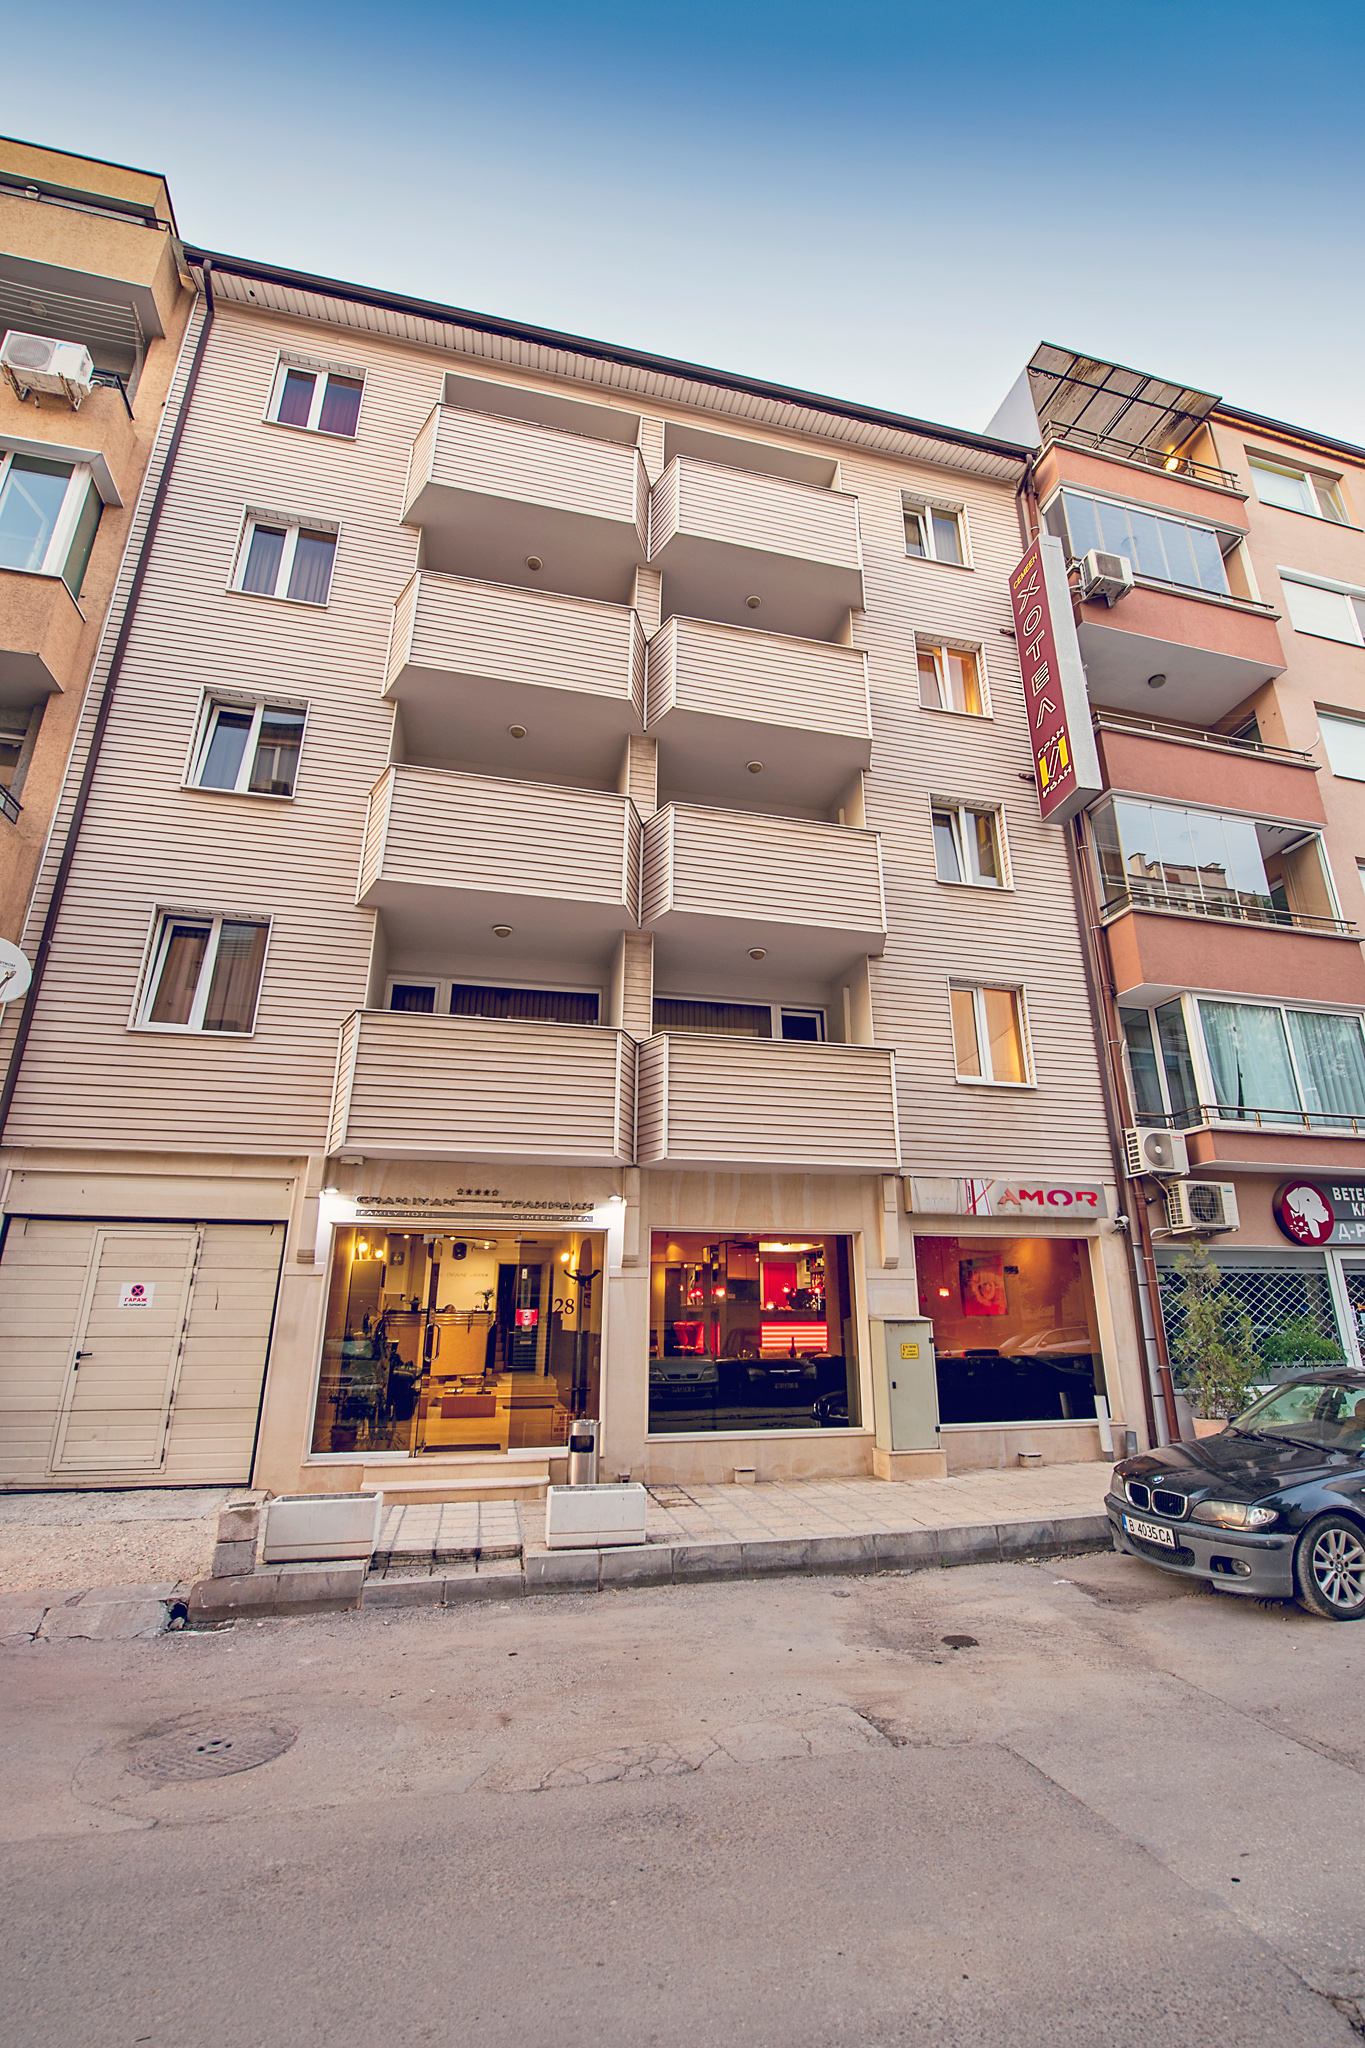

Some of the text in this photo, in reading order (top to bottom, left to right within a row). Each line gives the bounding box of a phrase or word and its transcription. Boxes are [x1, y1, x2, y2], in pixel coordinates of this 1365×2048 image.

[1013, 552, 1038, 590] СЕМЕЕН
[1017, 569, 1056, 729] ХОТЕЛ
[1037, 725, 1065, 759] ГРАН
[1042, 765, 1072, 798] ИВАН
[356, 1196, 455, 1206] GRAN IVAN
[997, 1188, 1098, 1207] AMOR
[1332, 1187, 1365, 1201] ВЕТЕ
[554, 1298, 575, 1315] 28
